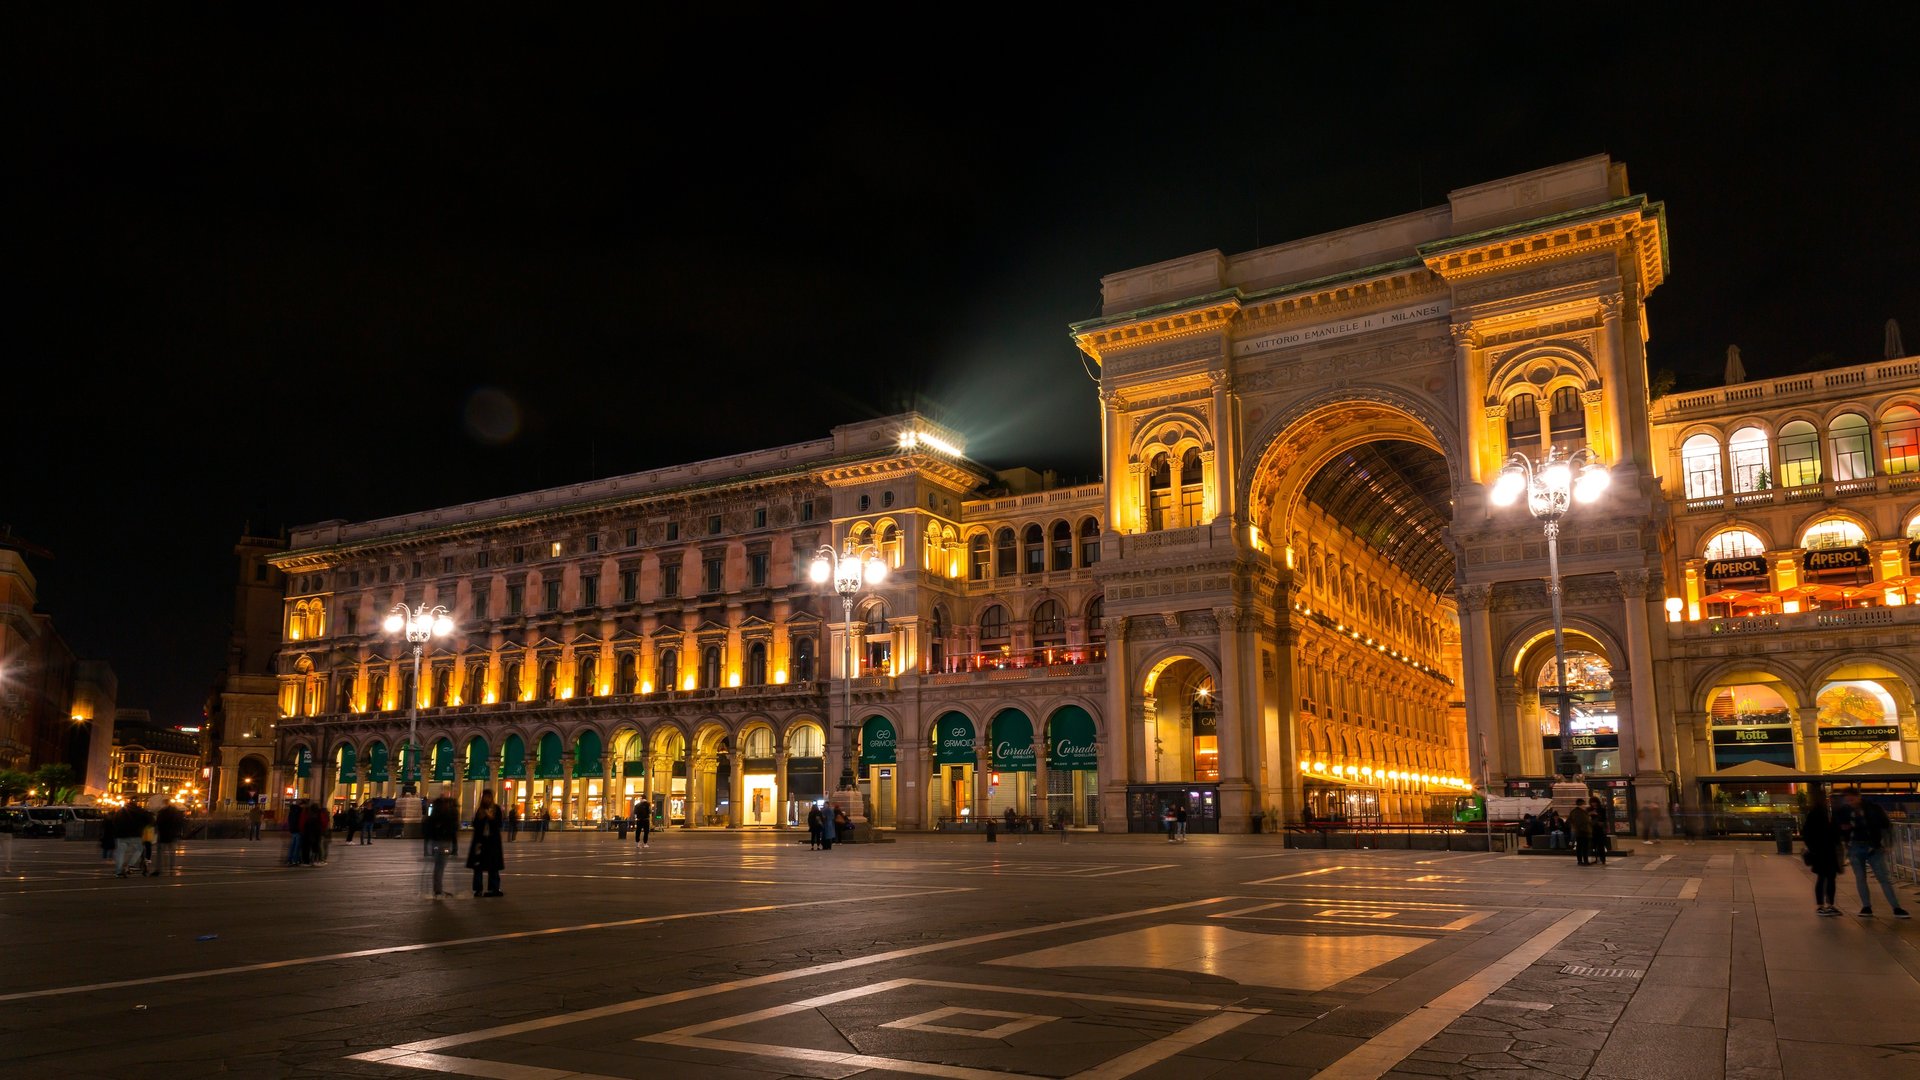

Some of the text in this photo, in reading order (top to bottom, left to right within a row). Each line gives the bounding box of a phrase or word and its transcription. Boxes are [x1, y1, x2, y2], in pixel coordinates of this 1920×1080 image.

[1255, 334, 1300, 349] VITTORIO
[1304, 322, 1360, 340] EMANUELE
[1391, 305, 1441, 323] MILANESI
[1810, 551, 1862, 565] APEROL
[1712, 560, 1761, 575] APEROL
[1735, 730, 1769, 740] Motta
[869, 739, 897, 748] GRIMOLD
[943, 738, 975, 748] GRIMOLD
